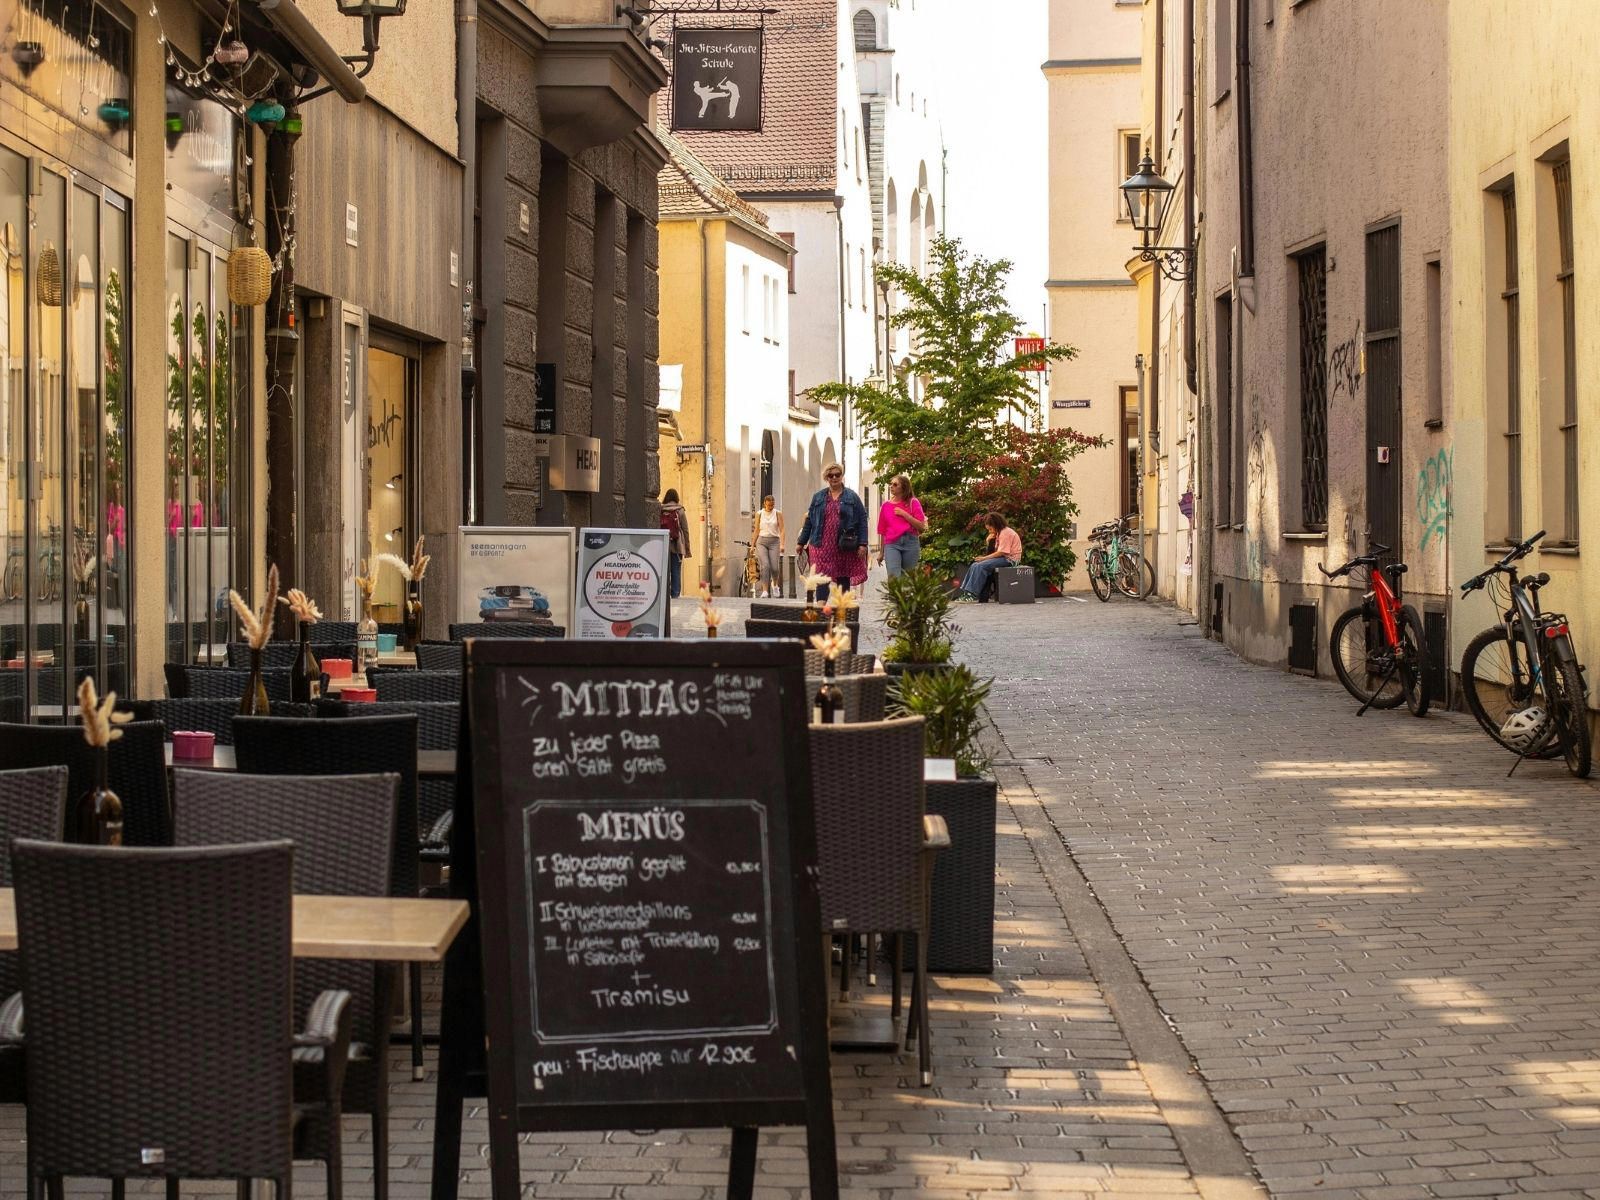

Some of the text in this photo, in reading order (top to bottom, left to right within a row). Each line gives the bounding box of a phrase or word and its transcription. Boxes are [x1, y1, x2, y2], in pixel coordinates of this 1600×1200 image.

[679, 43, 757, 54] Jiu-Jitsu-Karate
[702, 58, 734, 68] Schule
[470, 543, 527, 551] seemannsgarn
[595, 571, 650, 581] NEW YOU
[551, 679, 700, 718] MITTAG
[566, 732, 612, 763] jeder
[620, 730, 661, 750] Pizza
[577, 757, 613, 777] Salat
[623, 756, 667, 784] gratis
[577, 806, 685, 842] MENÜS
[590, 984, 690, 1008] Tiramisu
[576, 1047, 663, 1075] Fischsuppe
